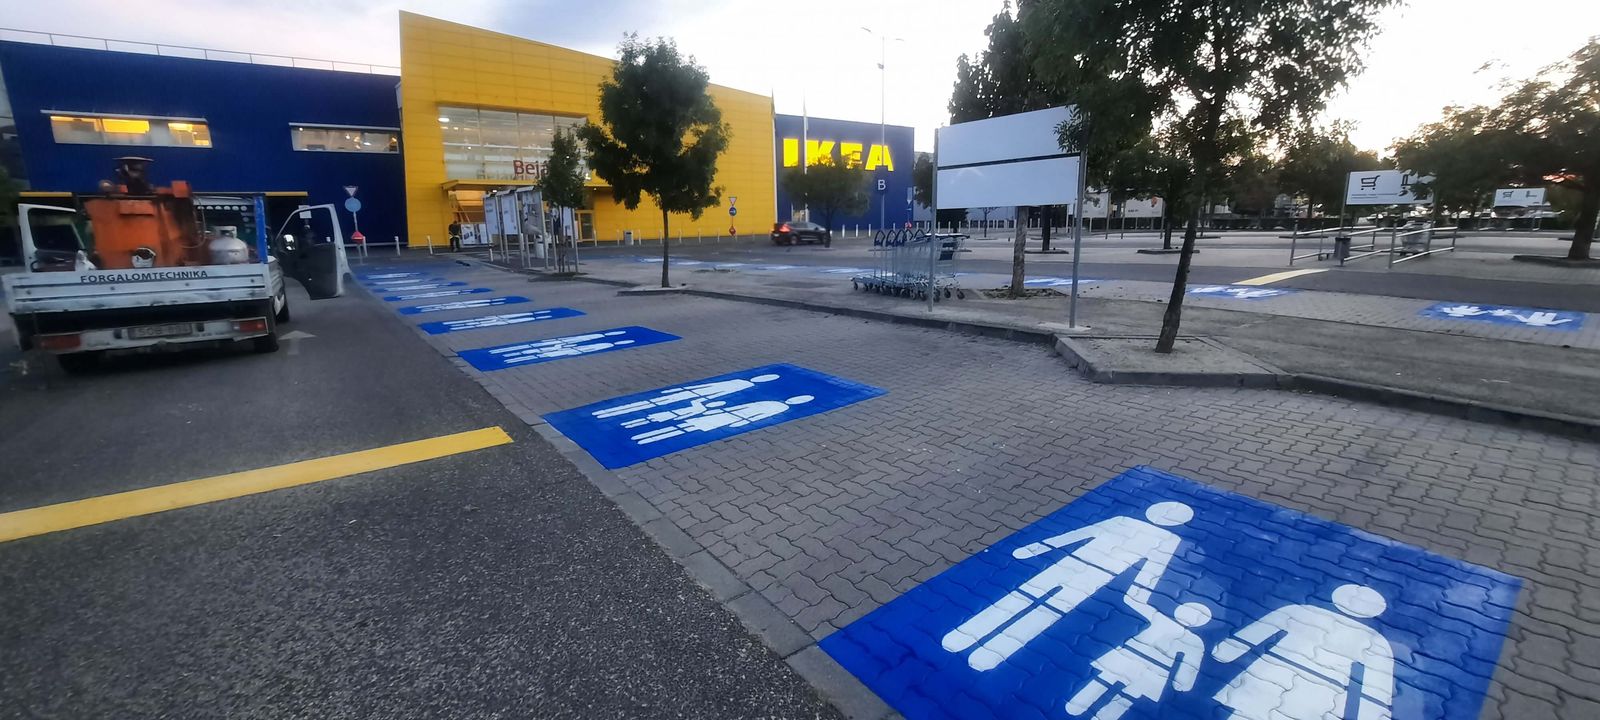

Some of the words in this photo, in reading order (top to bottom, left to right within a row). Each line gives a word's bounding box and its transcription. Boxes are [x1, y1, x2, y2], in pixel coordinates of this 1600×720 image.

[783, 138, 894, 172] IKEA
[513, 159, 550, 180] Bejá
[877, 180, 887, 191] B
[80, 270, 208, 283] FORGALOMTECHNIKA
